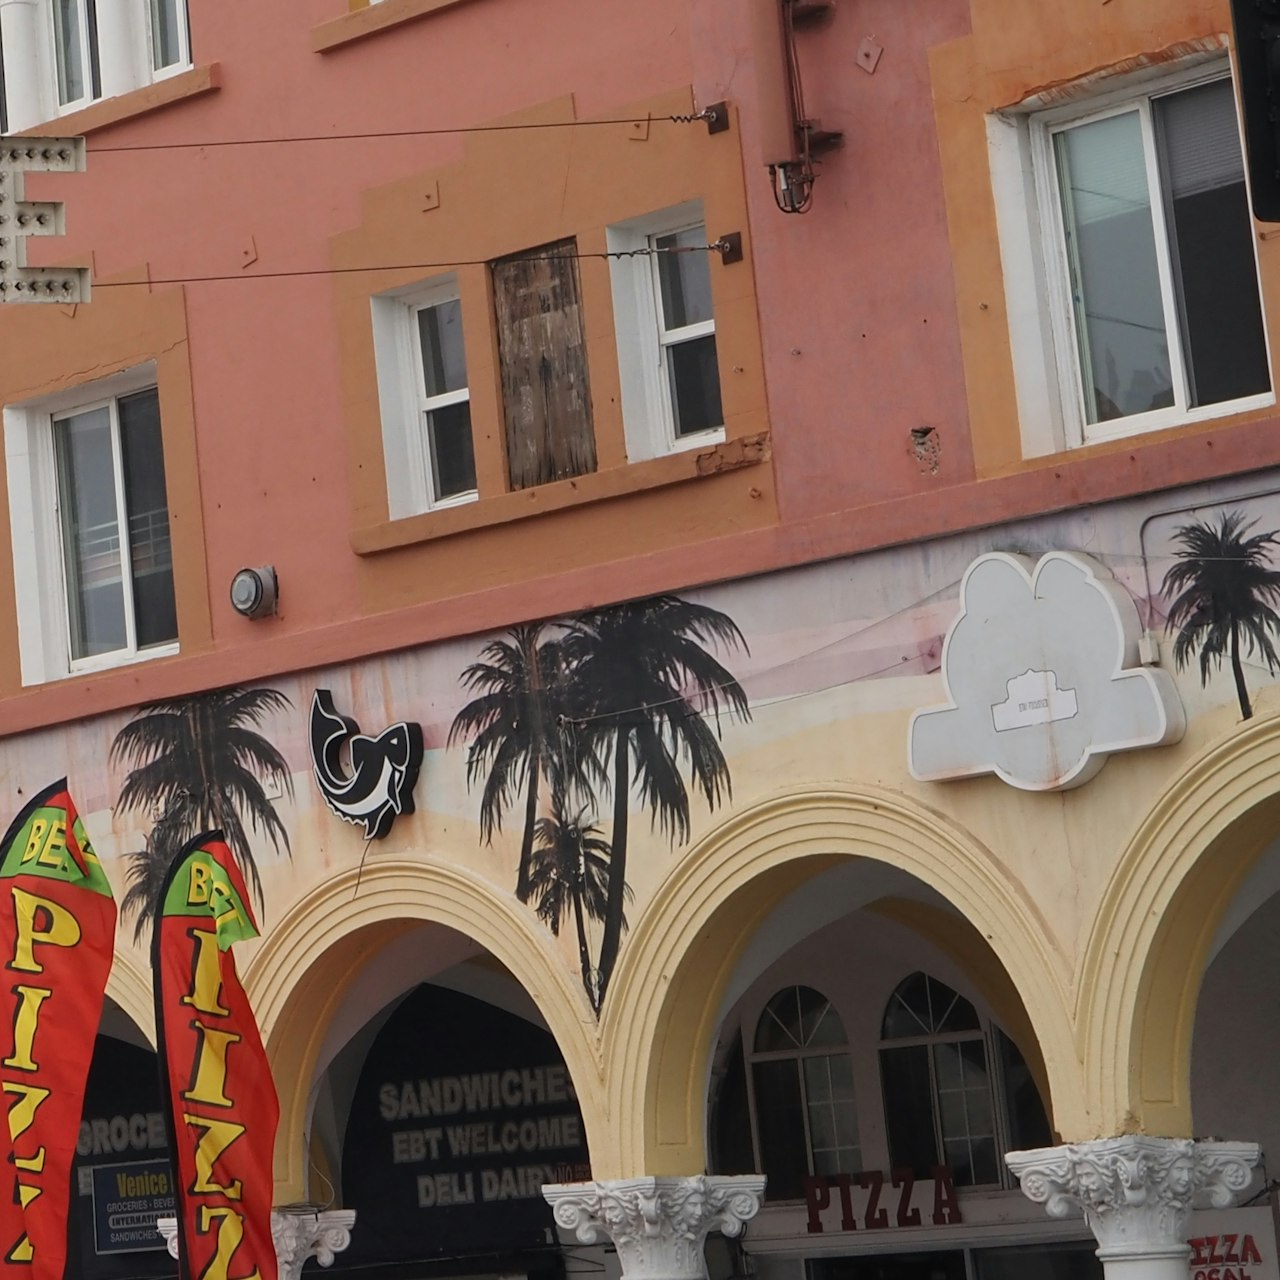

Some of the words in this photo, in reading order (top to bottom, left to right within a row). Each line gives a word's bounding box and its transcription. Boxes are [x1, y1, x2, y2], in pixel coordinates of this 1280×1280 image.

[77, 1111, 169, 1156] GROCE
[392, 1127, 443, 1164] EBT
[446, 1115, 581, 1158] WELCOME
[116, 1171, 169, 1198] Venice
[416, 1172, 475, 1208] DELI
[805, 1165, 963, 1233] PIZZA
[106, 1199, 149, 1213] GROCERIES
[112, 1211, 176, 1227] INTERNATI
[110, 1230, 158, 1243] SANDWICHES
[1186, 1234, 1263, 1266] IZZA
